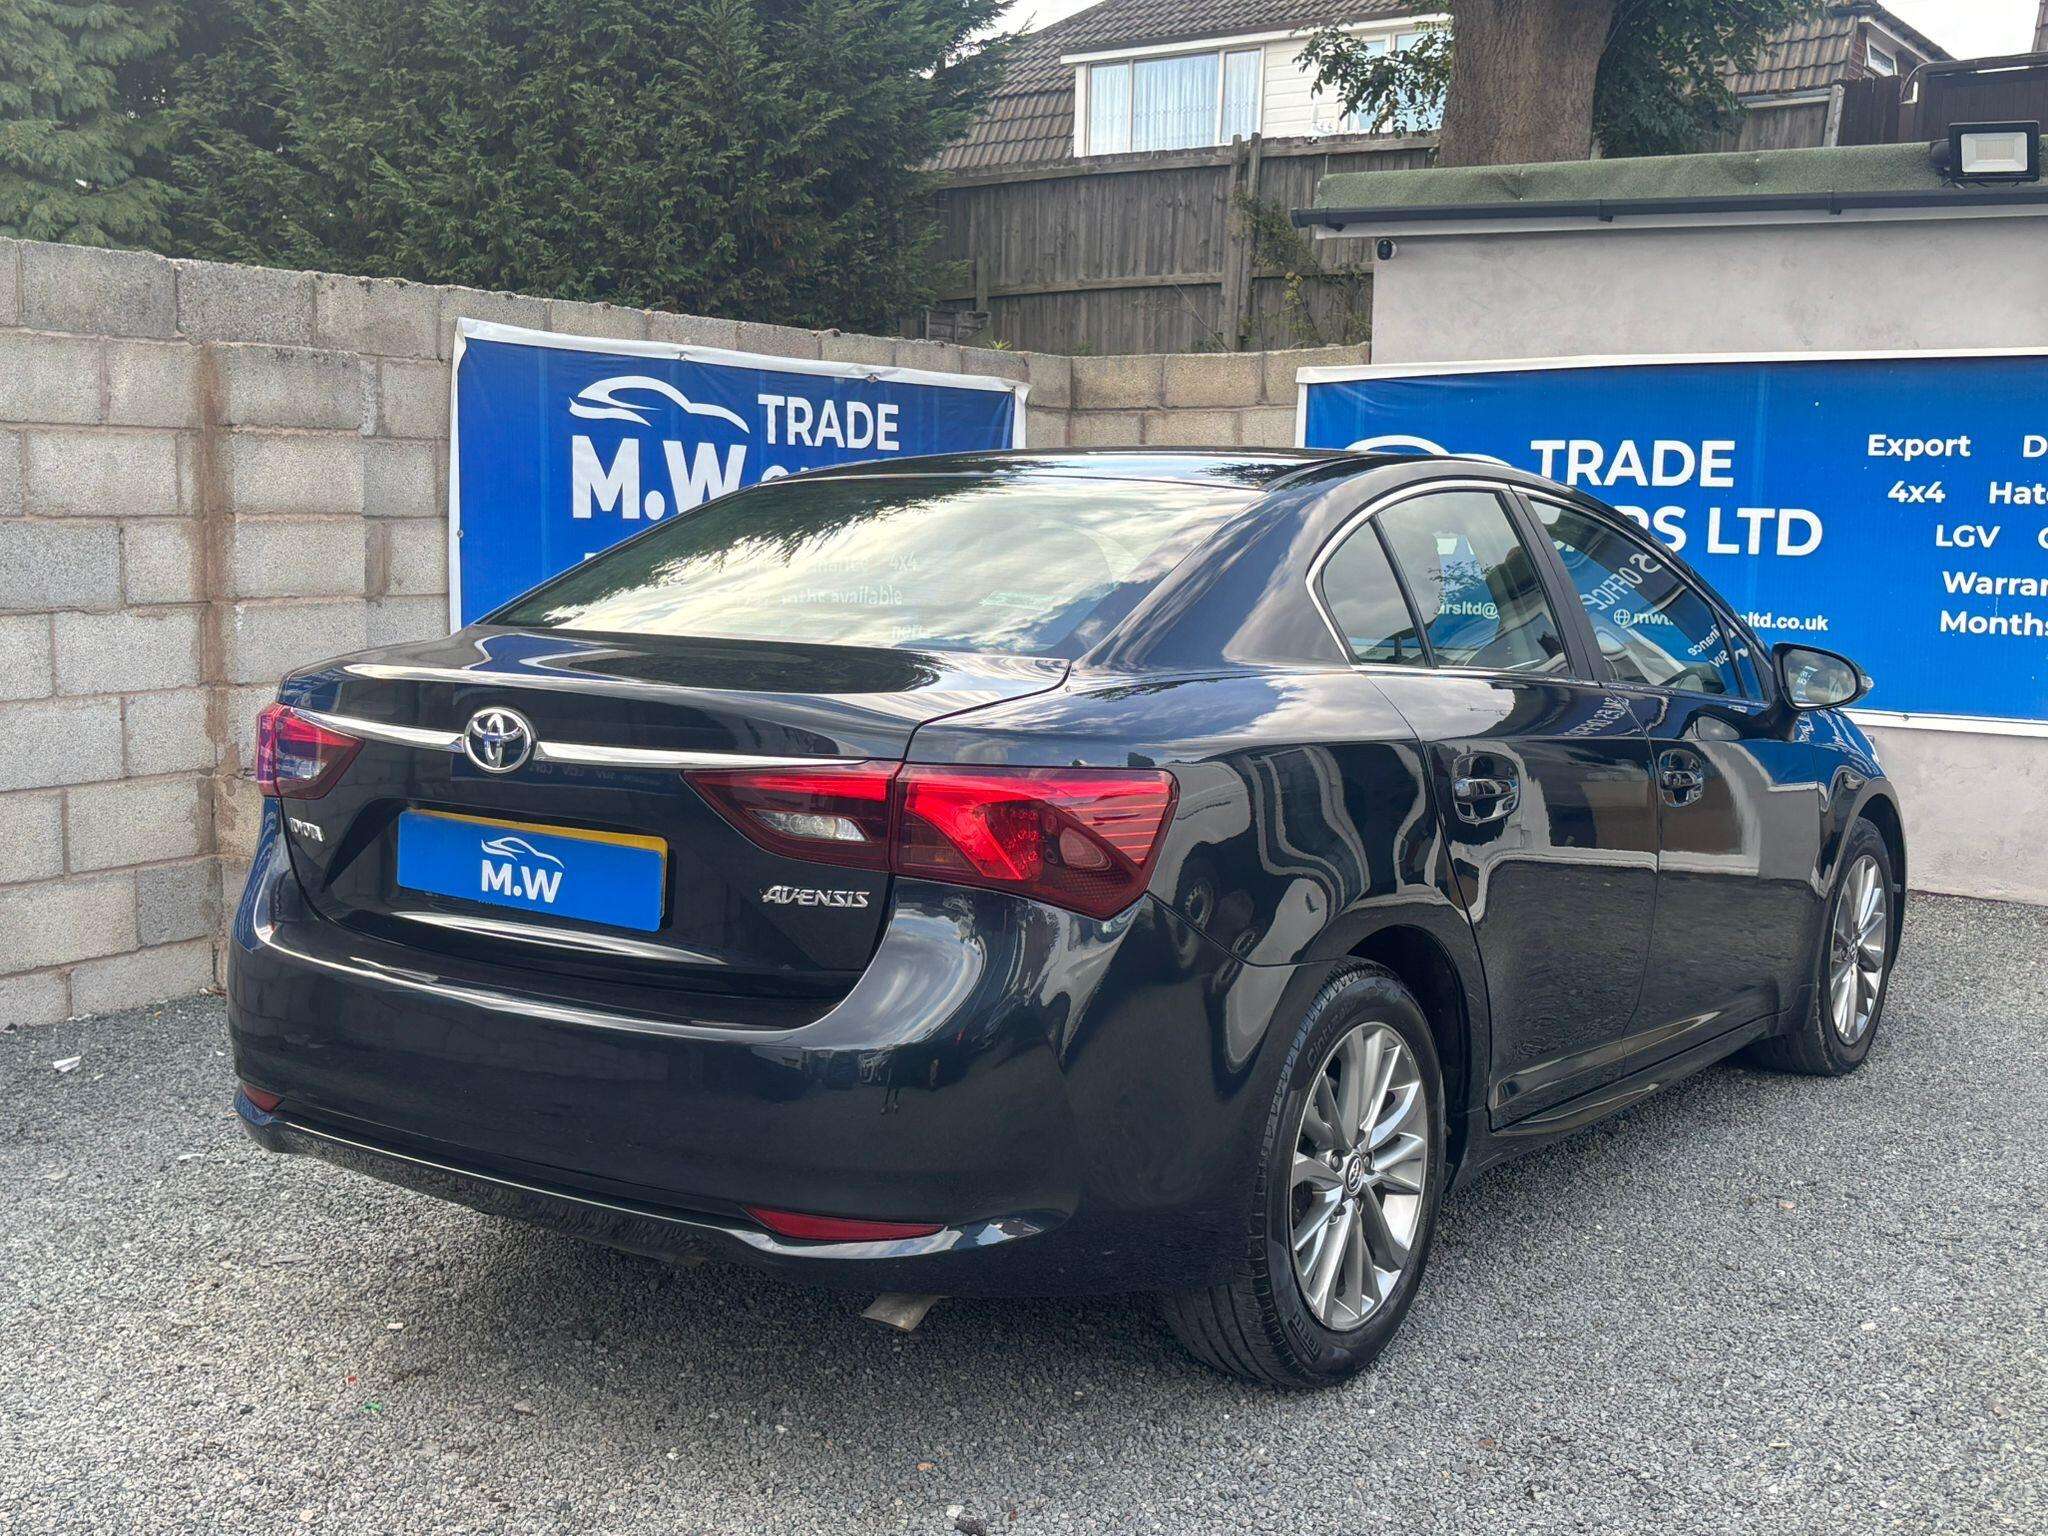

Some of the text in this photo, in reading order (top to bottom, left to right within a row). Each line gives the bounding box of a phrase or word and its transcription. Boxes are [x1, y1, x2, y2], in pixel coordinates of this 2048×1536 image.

[757, 393, 900, 451] TRADE
[1530, 439, 1736, 488] TRADE
[1867, 433, 1971, 461] Export
[571, 434, 748, 520] M.W
[1887, 480, 1946, 503] 4x4
[1707, 506, 1824, 556] LTD
[1935, 524, 2001, 549] LGV
[480, 859, 563, 904] M.W
[761, 885, 870, 909] AVENSIS
